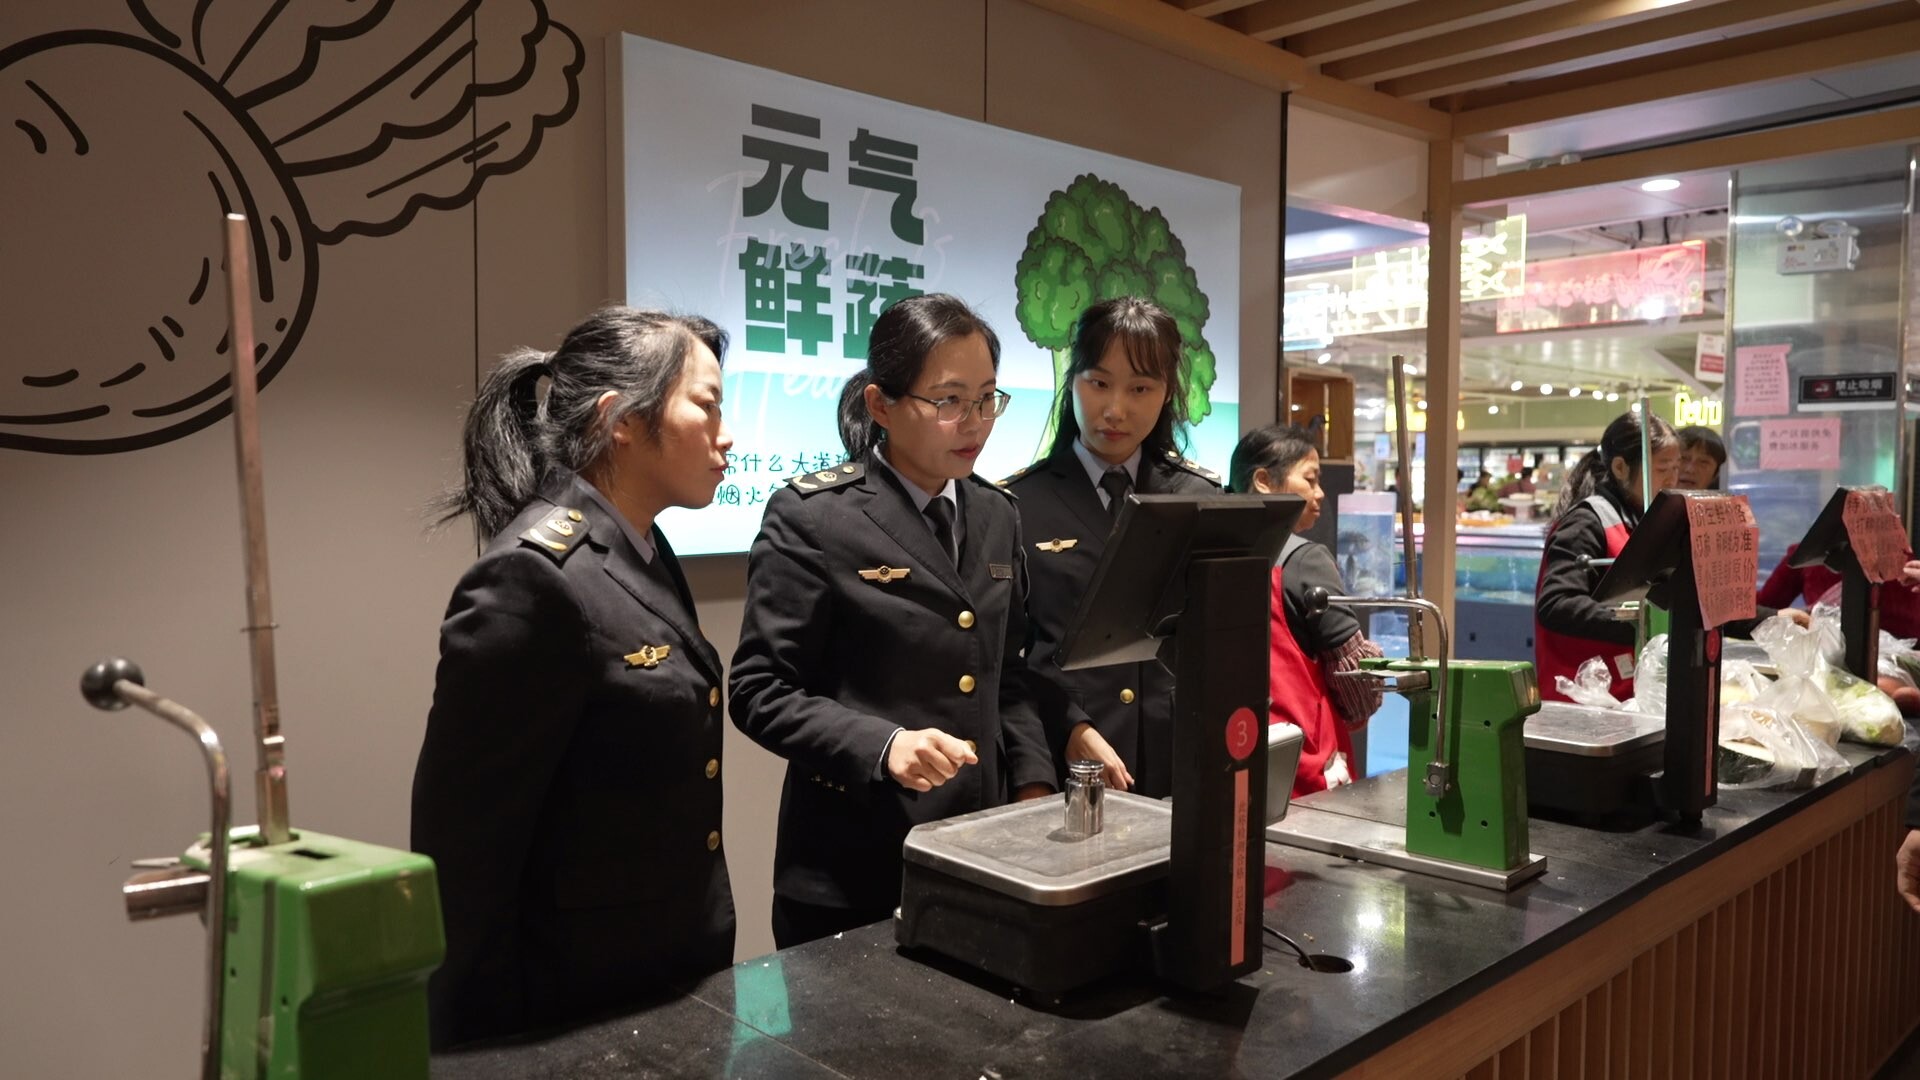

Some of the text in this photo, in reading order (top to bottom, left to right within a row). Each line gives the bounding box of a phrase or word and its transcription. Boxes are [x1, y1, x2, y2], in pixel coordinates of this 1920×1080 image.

[742, 103, 925, 246] 元气
[738, 236, 925, 360] 鲜蔬
[717, 483, 784, 506] 烟火
[1236, 720, 1248, 747] 3
